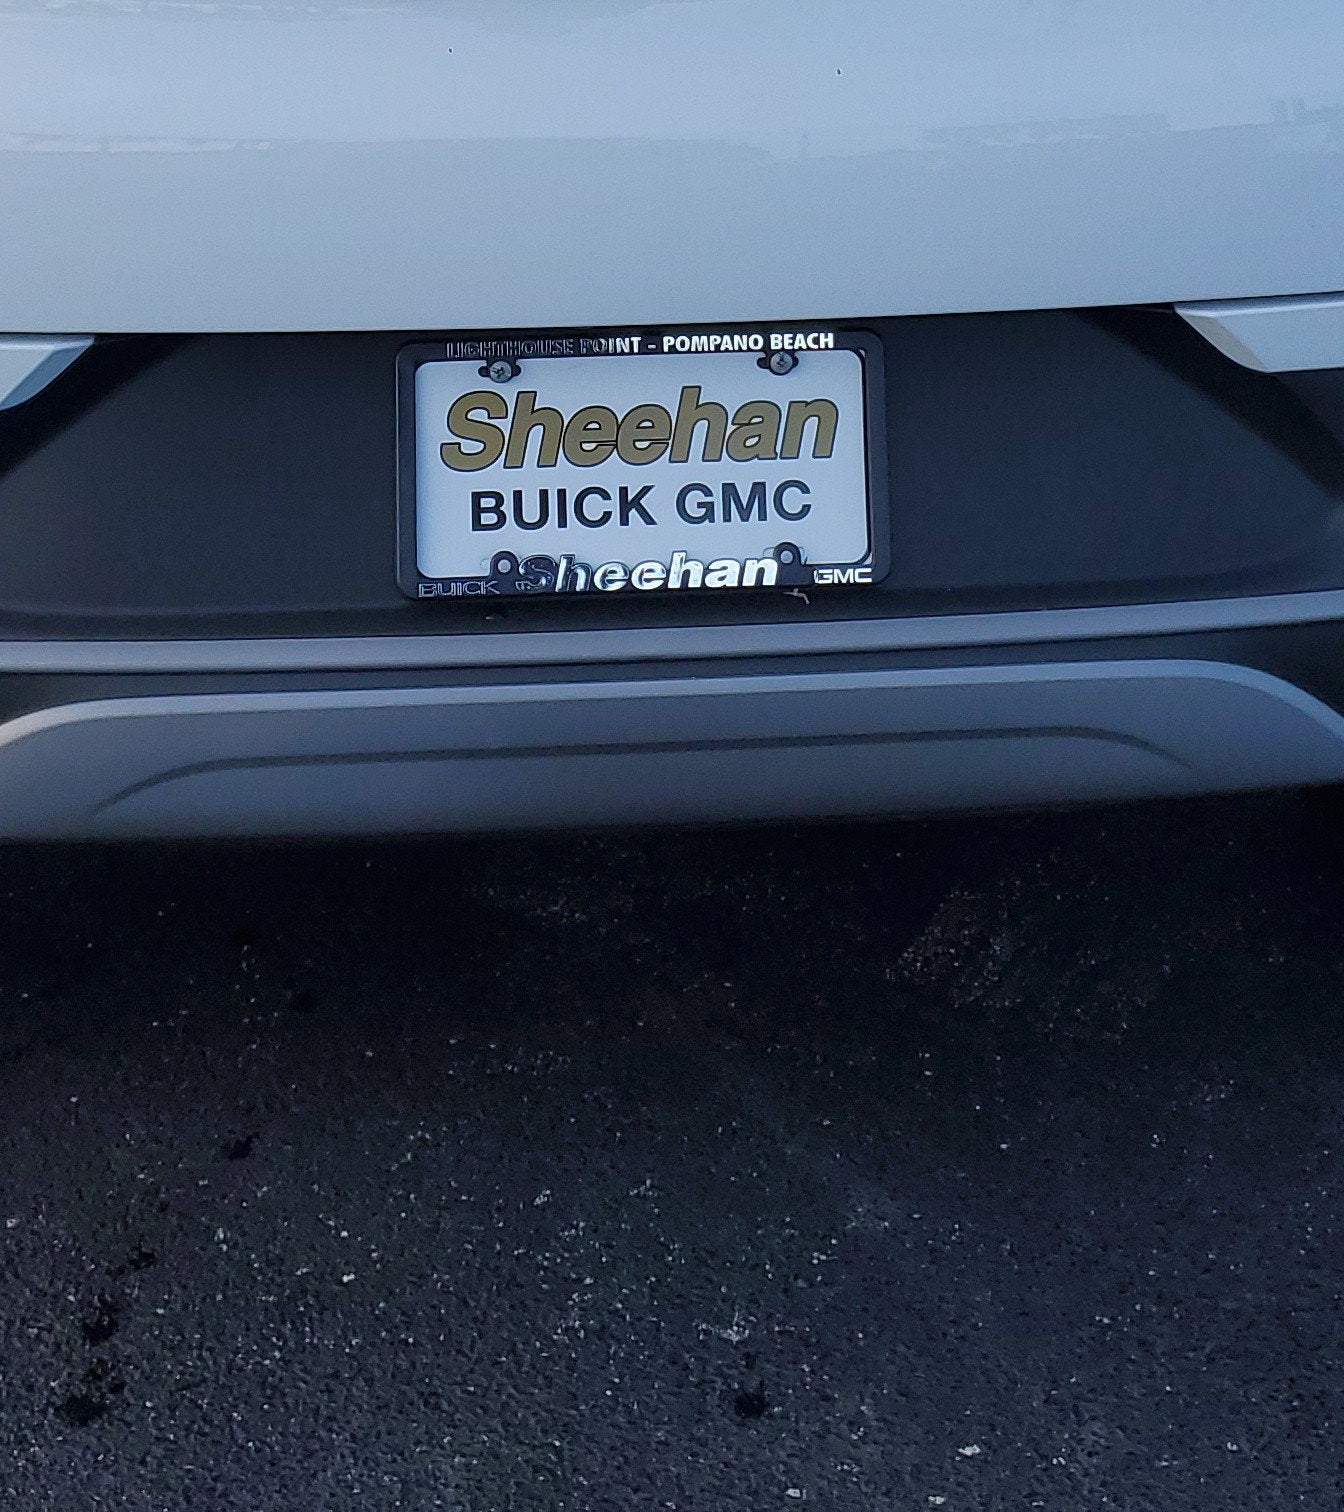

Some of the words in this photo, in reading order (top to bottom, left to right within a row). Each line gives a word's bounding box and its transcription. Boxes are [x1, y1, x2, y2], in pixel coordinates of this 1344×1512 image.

[446, 338, 574, 359] LIGHTHOUSE
[580, 336, 642, 355] POINT
[662, 334, 764, 353] POMPANO
[769, 332, 834, 351] BEACH
[440, 386, 839, 472] Sheehan
[471, 484, 657, 532] BUICK
[675, 479, 812, 524] GMC
[418, 580, 500, 598] BUICK
[515, 550, 778, 597] Sheehan
[814, 567, 873, 585] GMC
